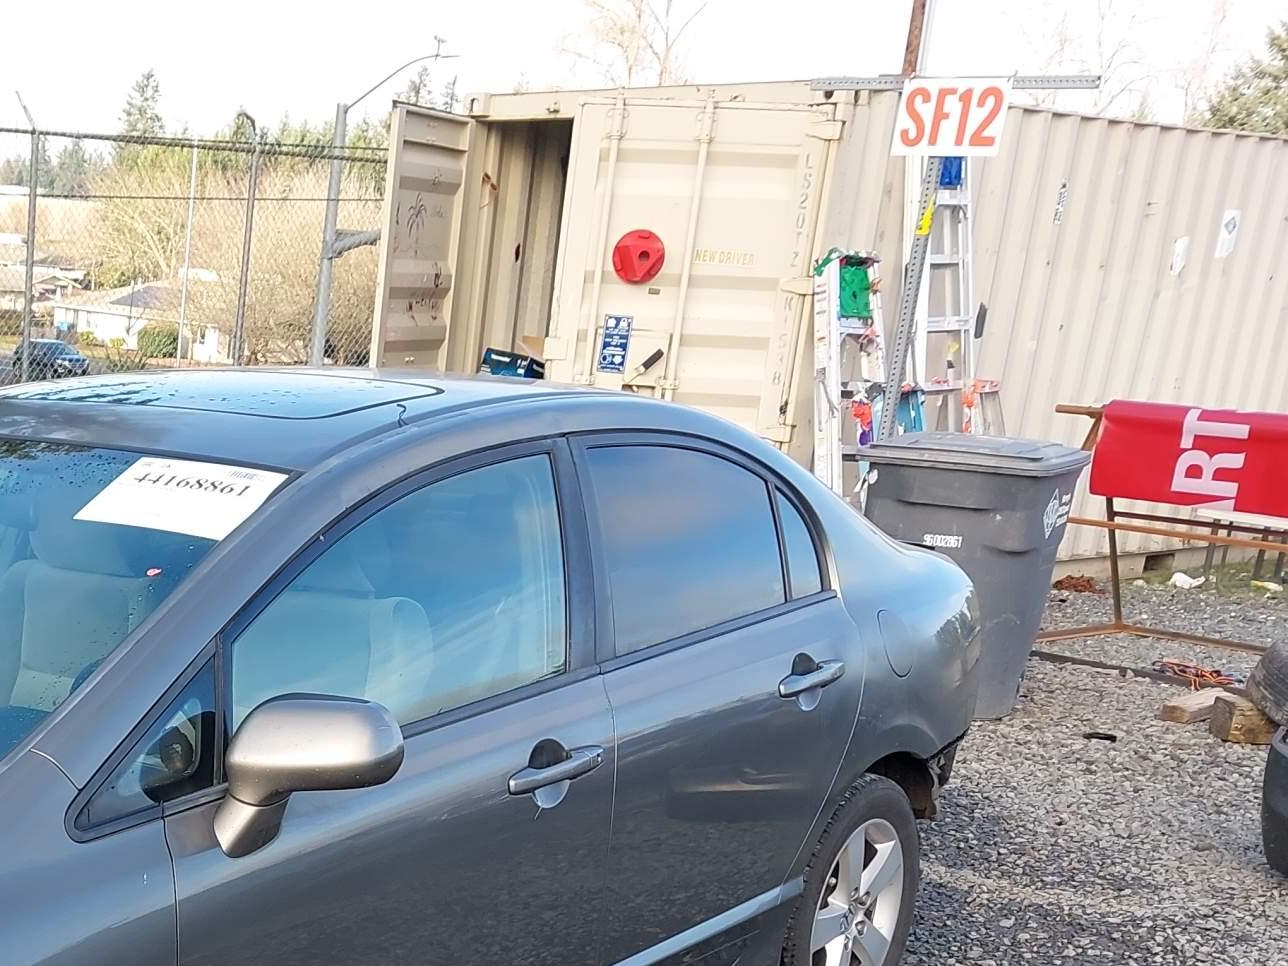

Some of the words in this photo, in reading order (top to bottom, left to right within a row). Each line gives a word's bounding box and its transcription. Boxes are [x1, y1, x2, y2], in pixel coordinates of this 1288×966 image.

[900, 87, 1004, 147] SF12
[134, 472, 252, 496] 44168861
[1171, 408, 1250, 511] RT
